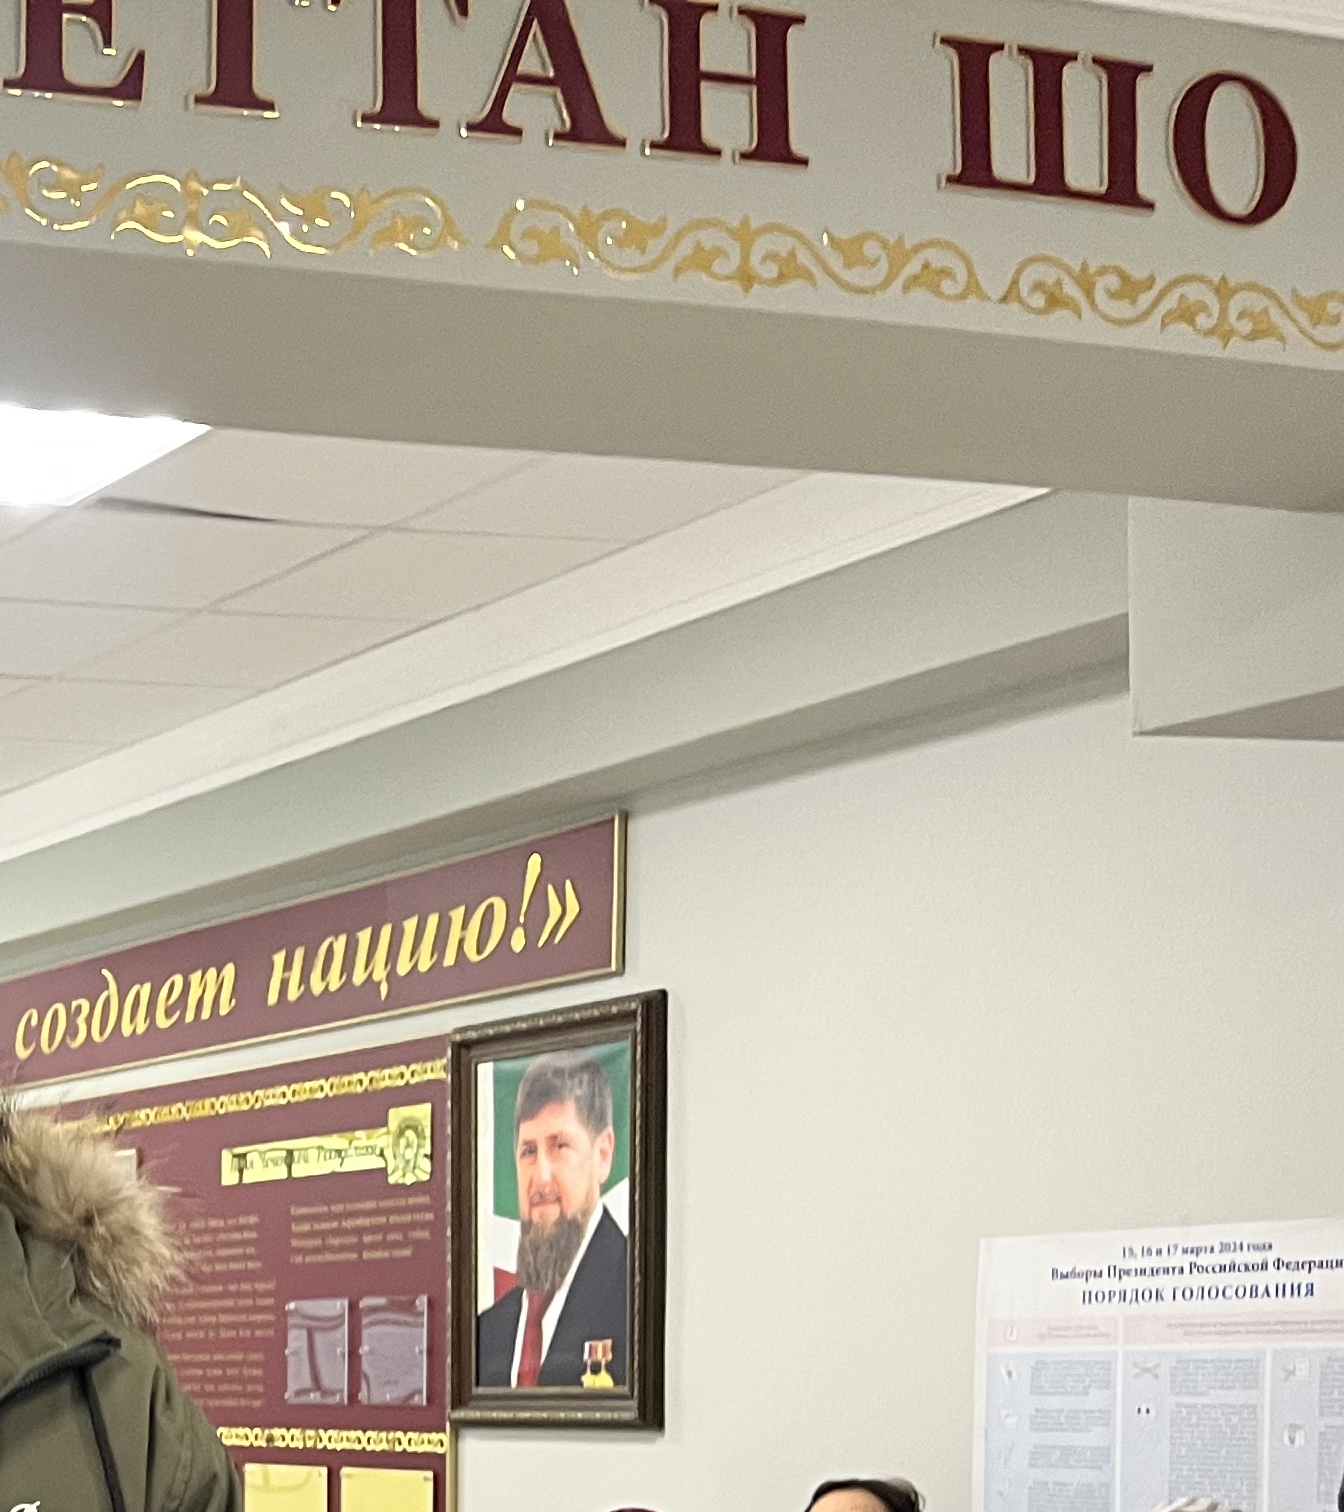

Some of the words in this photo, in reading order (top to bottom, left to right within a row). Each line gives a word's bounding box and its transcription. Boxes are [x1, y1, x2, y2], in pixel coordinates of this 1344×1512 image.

[934, 33, 1299, 226] ШО
[14, 962, 236, 1060] создает
[266, 851, 581, 1008] нацию!»
[1051, 1266, 1104, 1284] Выборы
[1107, 1264, 1185, 1282] Президента
[1188, 1257, 1269, 1275] Российской
[1081, 1288, 1165, 1305] ПОРЯДОК
[1171, 1282, 1315, 1301] ГОЛОСОВАНИЯ
